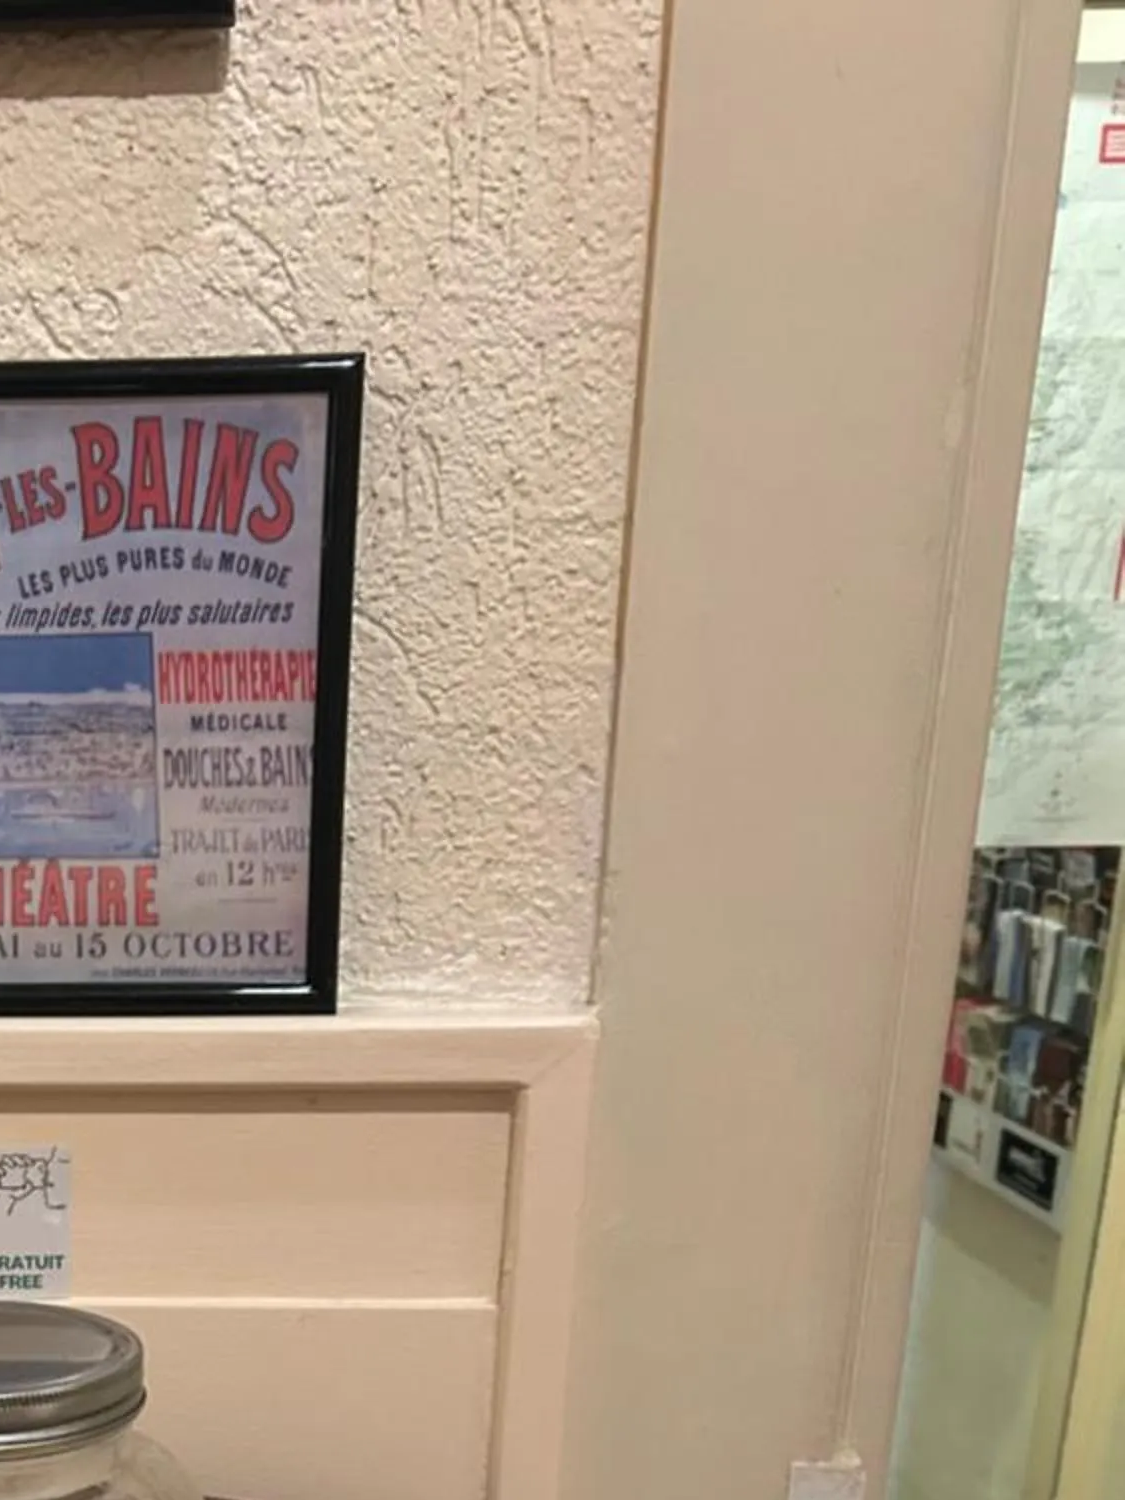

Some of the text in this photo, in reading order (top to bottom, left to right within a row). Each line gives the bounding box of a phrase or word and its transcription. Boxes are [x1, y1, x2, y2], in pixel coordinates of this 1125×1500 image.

[18, 546, 293, 600] LES PLUS PURES du MONDE
[102, 600, 132, 627] les
[136, 599, 182, 630] plus
[187, 597, 295, 624] salutaires
[190, 712, 287, 732] MÉDICALE
[163, 743, 313, 791] DOUCHES & BAIN
[260, 826, 308, 854] PARI
[227, 860, 255, 886] 12
[33, 939, 63, 958] au
[76, 932, 107, 959] 15
[124, 928, 295, 959] OCTOBRE
